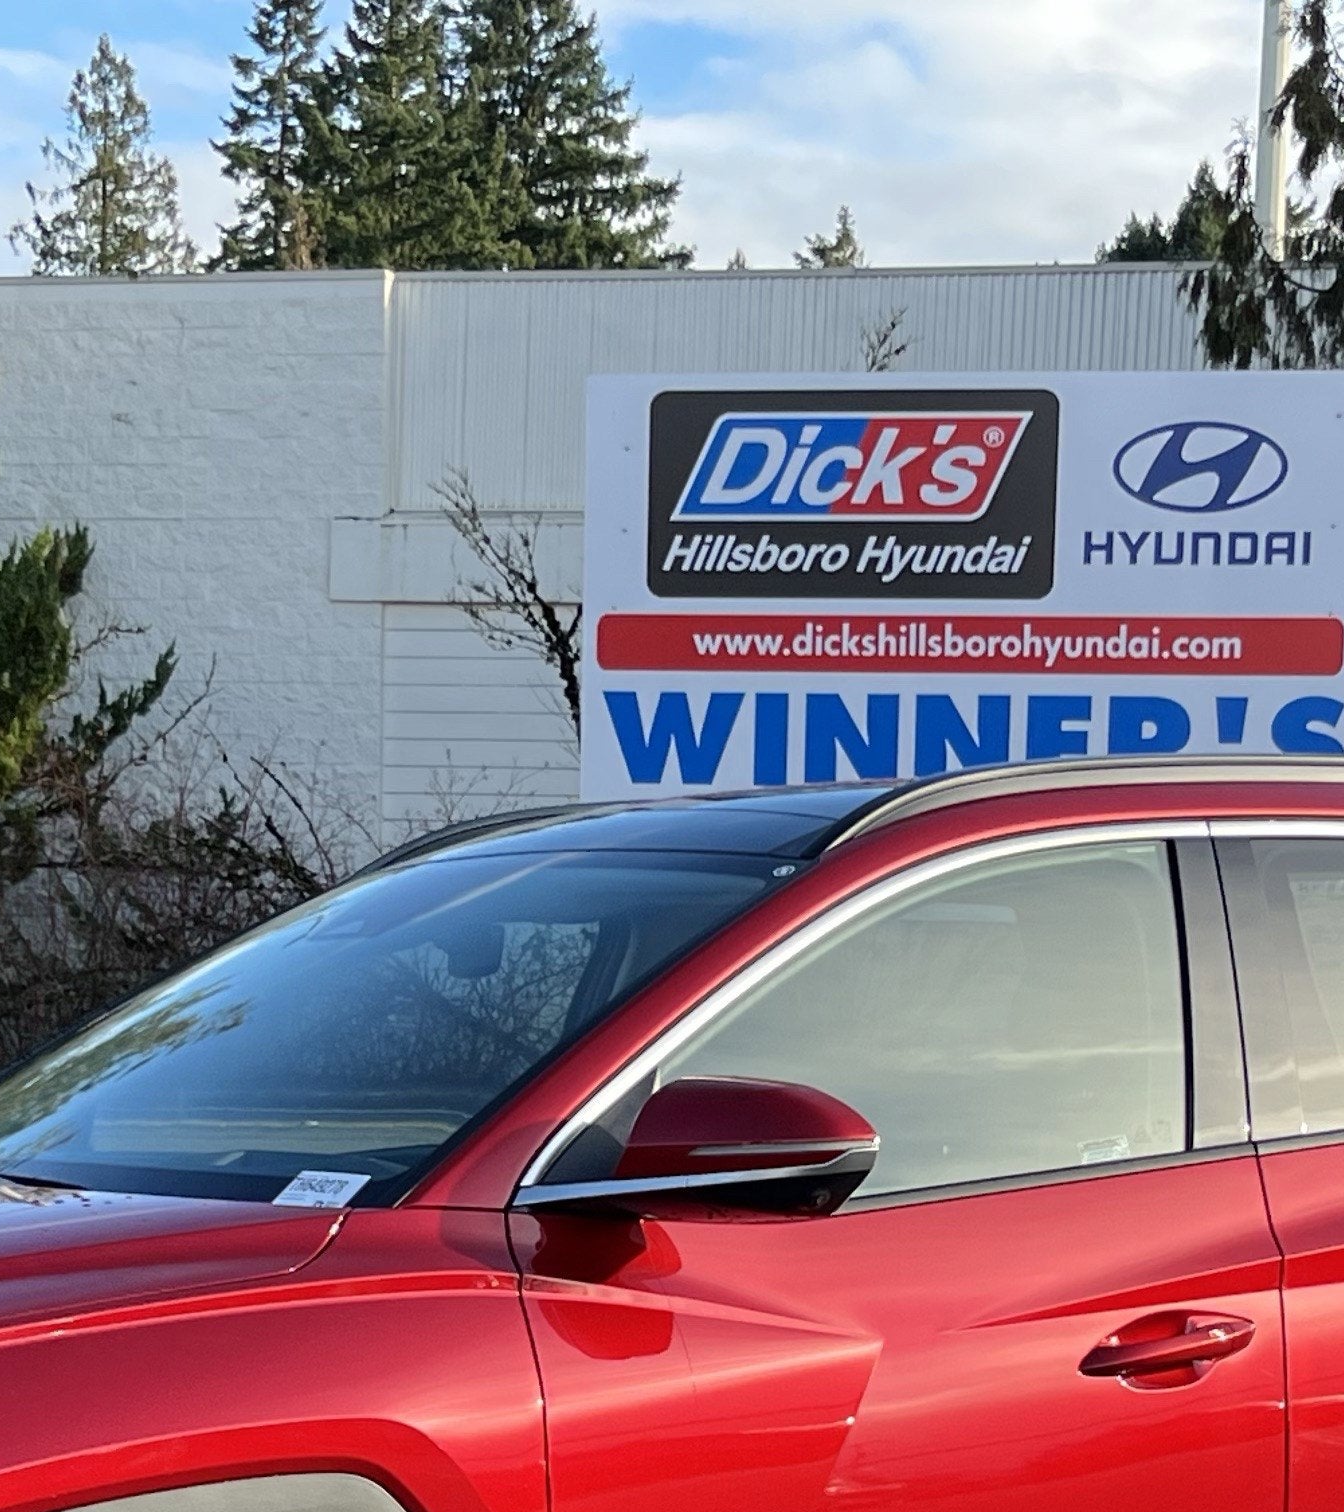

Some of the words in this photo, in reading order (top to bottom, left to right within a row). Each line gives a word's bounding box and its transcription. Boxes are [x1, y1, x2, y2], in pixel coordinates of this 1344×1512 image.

[698, 422, 988, 507] Dick's
[663, 534, 853, 575] Hillsboro
[856, 535, 1033, 583] Hyundai
[1083, 531, 1312, 567] HYUNDAI
[694, 623, 1242, 667] www.dickshillsborohyundai.com
